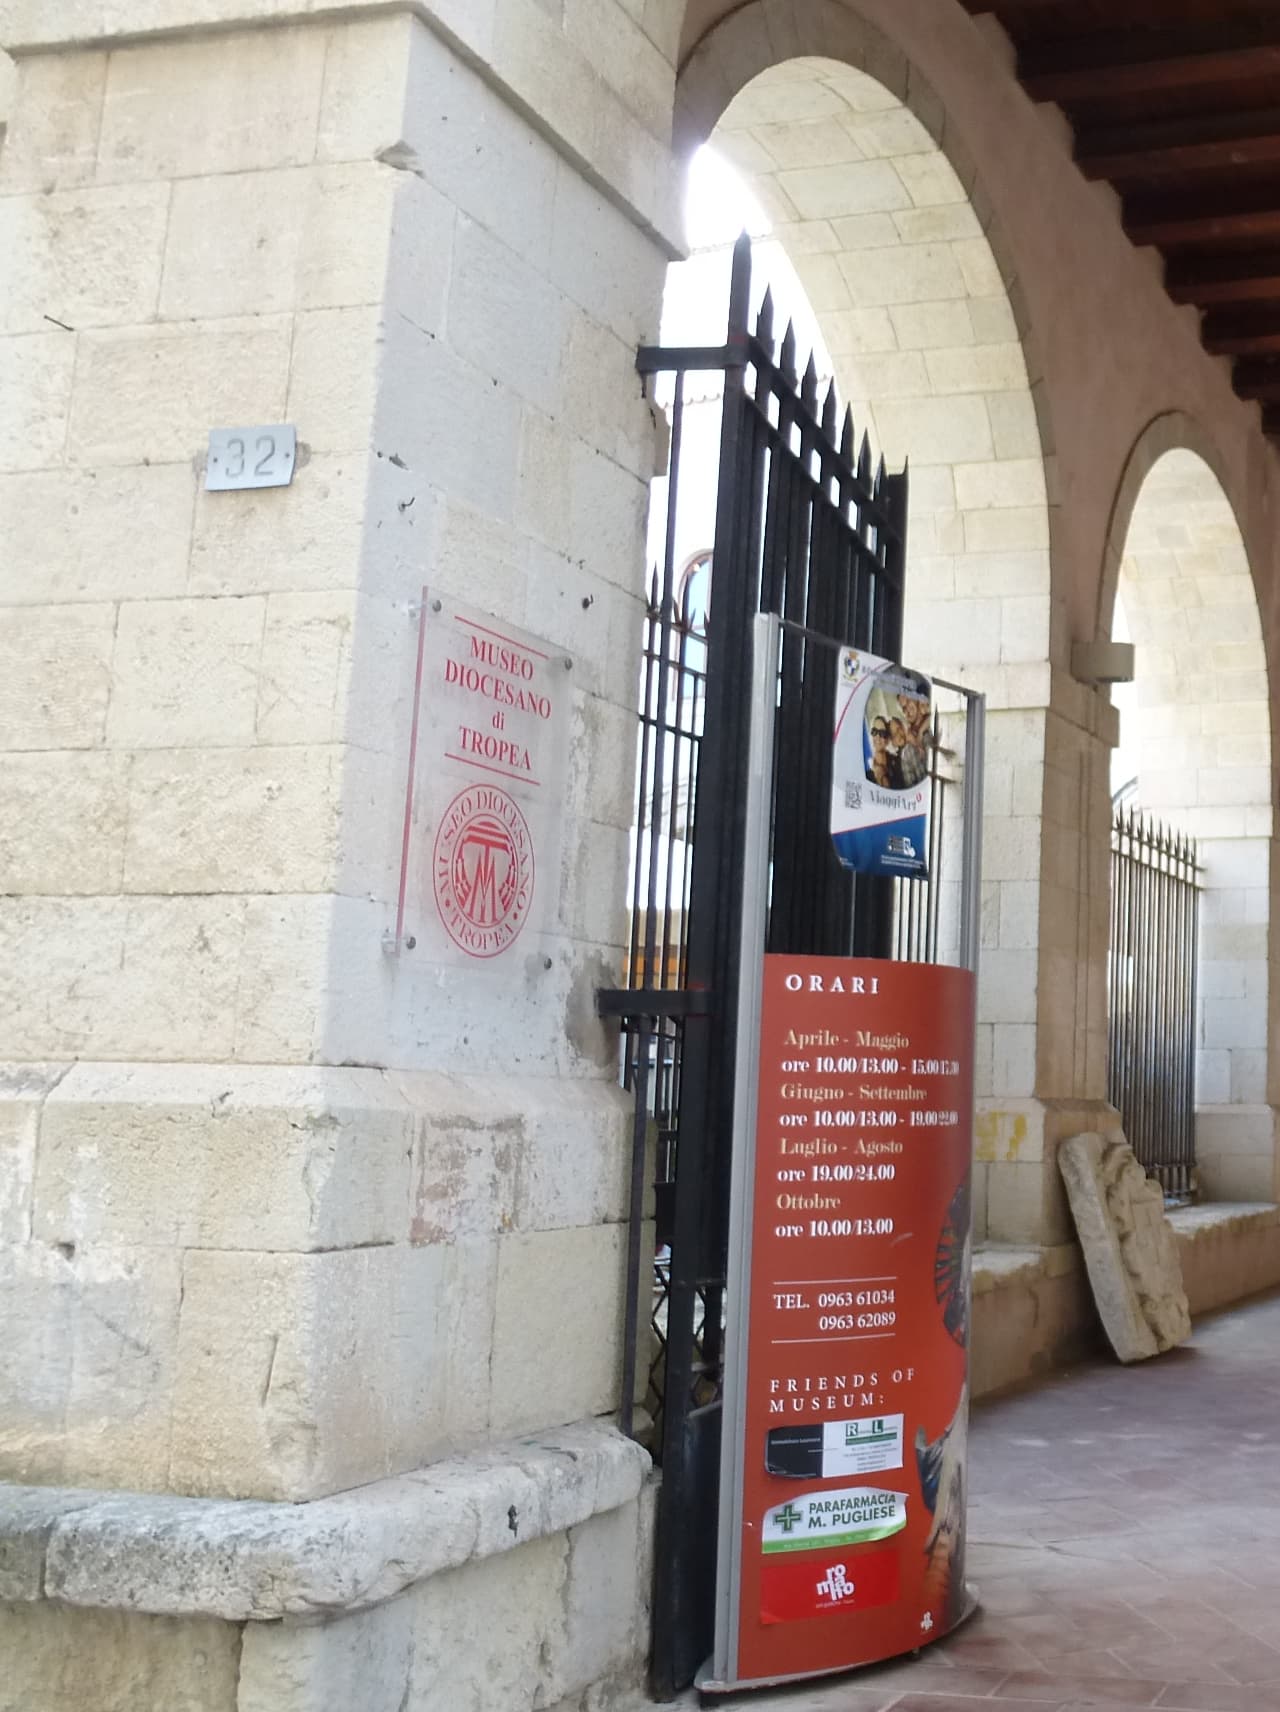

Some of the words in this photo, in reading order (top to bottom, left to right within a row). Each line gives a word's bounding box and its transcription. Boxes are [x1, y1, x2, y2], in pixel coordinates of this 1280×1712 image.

[226, 435, 276, 478] 32
[470, 635, 534, 682] MUSEO
[444, 658, 552, 721] DIOCESANO
[492, 710, 505, 732] di
[459, 725, 532, 772] TROPEA
[785, 974, 879, 994] ORARI
[784, 1029, 840, 1050] Aprile
[856, 1030, 910, 1051] Maggio
[781, 1060, 810, 1073] ore
[815, 1057, 899, 1075] 10.00/13.00
[780, 1083, 844, 1103] Giugno
[859, 1084, 927, 1101] Settembre
[779, 1114, 808, 1127] ore
[813, 1110, 897, 1128] 10.00/13.00
[780, 1138, 838, 1158] Luglio
[854, 1138, 903, 1157] Agosto
[777, 1169, 806, 1182] ore
[811, 1164, 895, 1182] 19.00/24.00
[776, 1193, 841, 1210] Ottobre
[775, 1224, 804, 1238] ore
[809, 1218, 893, 1238] 10.00/13.00
[773, 1293, 810, 1310] TEL.
[818, 1291, 853, 1308] 0963
[856, 1289, 895, 1306] 61034
[819, 1314, 854, 1331] 0963
[857, 1311, 896, 1329] 62089
[770, 1372, 879, 1393] FRIENDS
[892, 1367, 915, 1383] OF
[769, 1392, 885, 1413] MUSEUM:
[809, 1494, 896, 1514] PARAFARMACIA
[808, 1517, 827, 1529] M.
[832, 1505, 895, 1526] PUGLIESE
